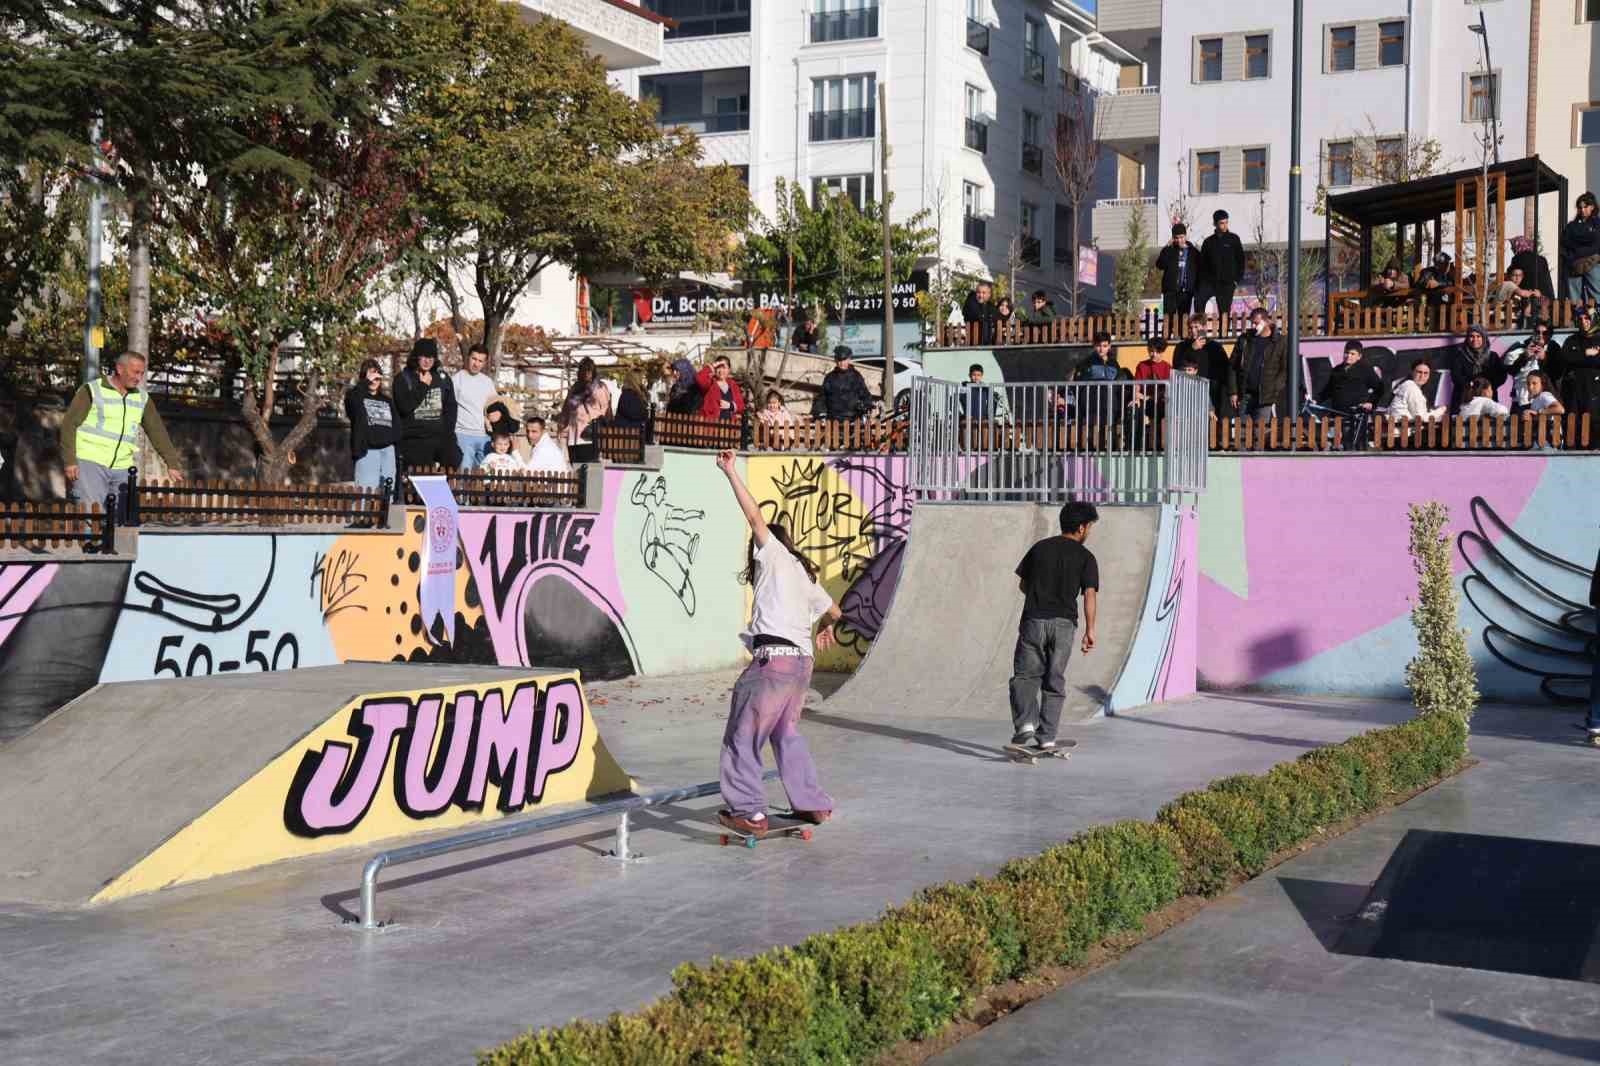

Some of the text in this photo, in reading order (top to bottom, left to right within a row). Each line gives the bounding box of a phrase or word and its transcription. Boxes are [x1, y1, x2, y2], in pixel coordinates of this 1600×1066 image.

[652, 297, 672, 314] Dr.
[679, 296, 754, 313] Barbaros
[864, 298, 883, 308] 217
[902, 297, 916, 307] 50
[154, 630, 300, 678] 50-50
[283, 677, 585, 839] JUMP
